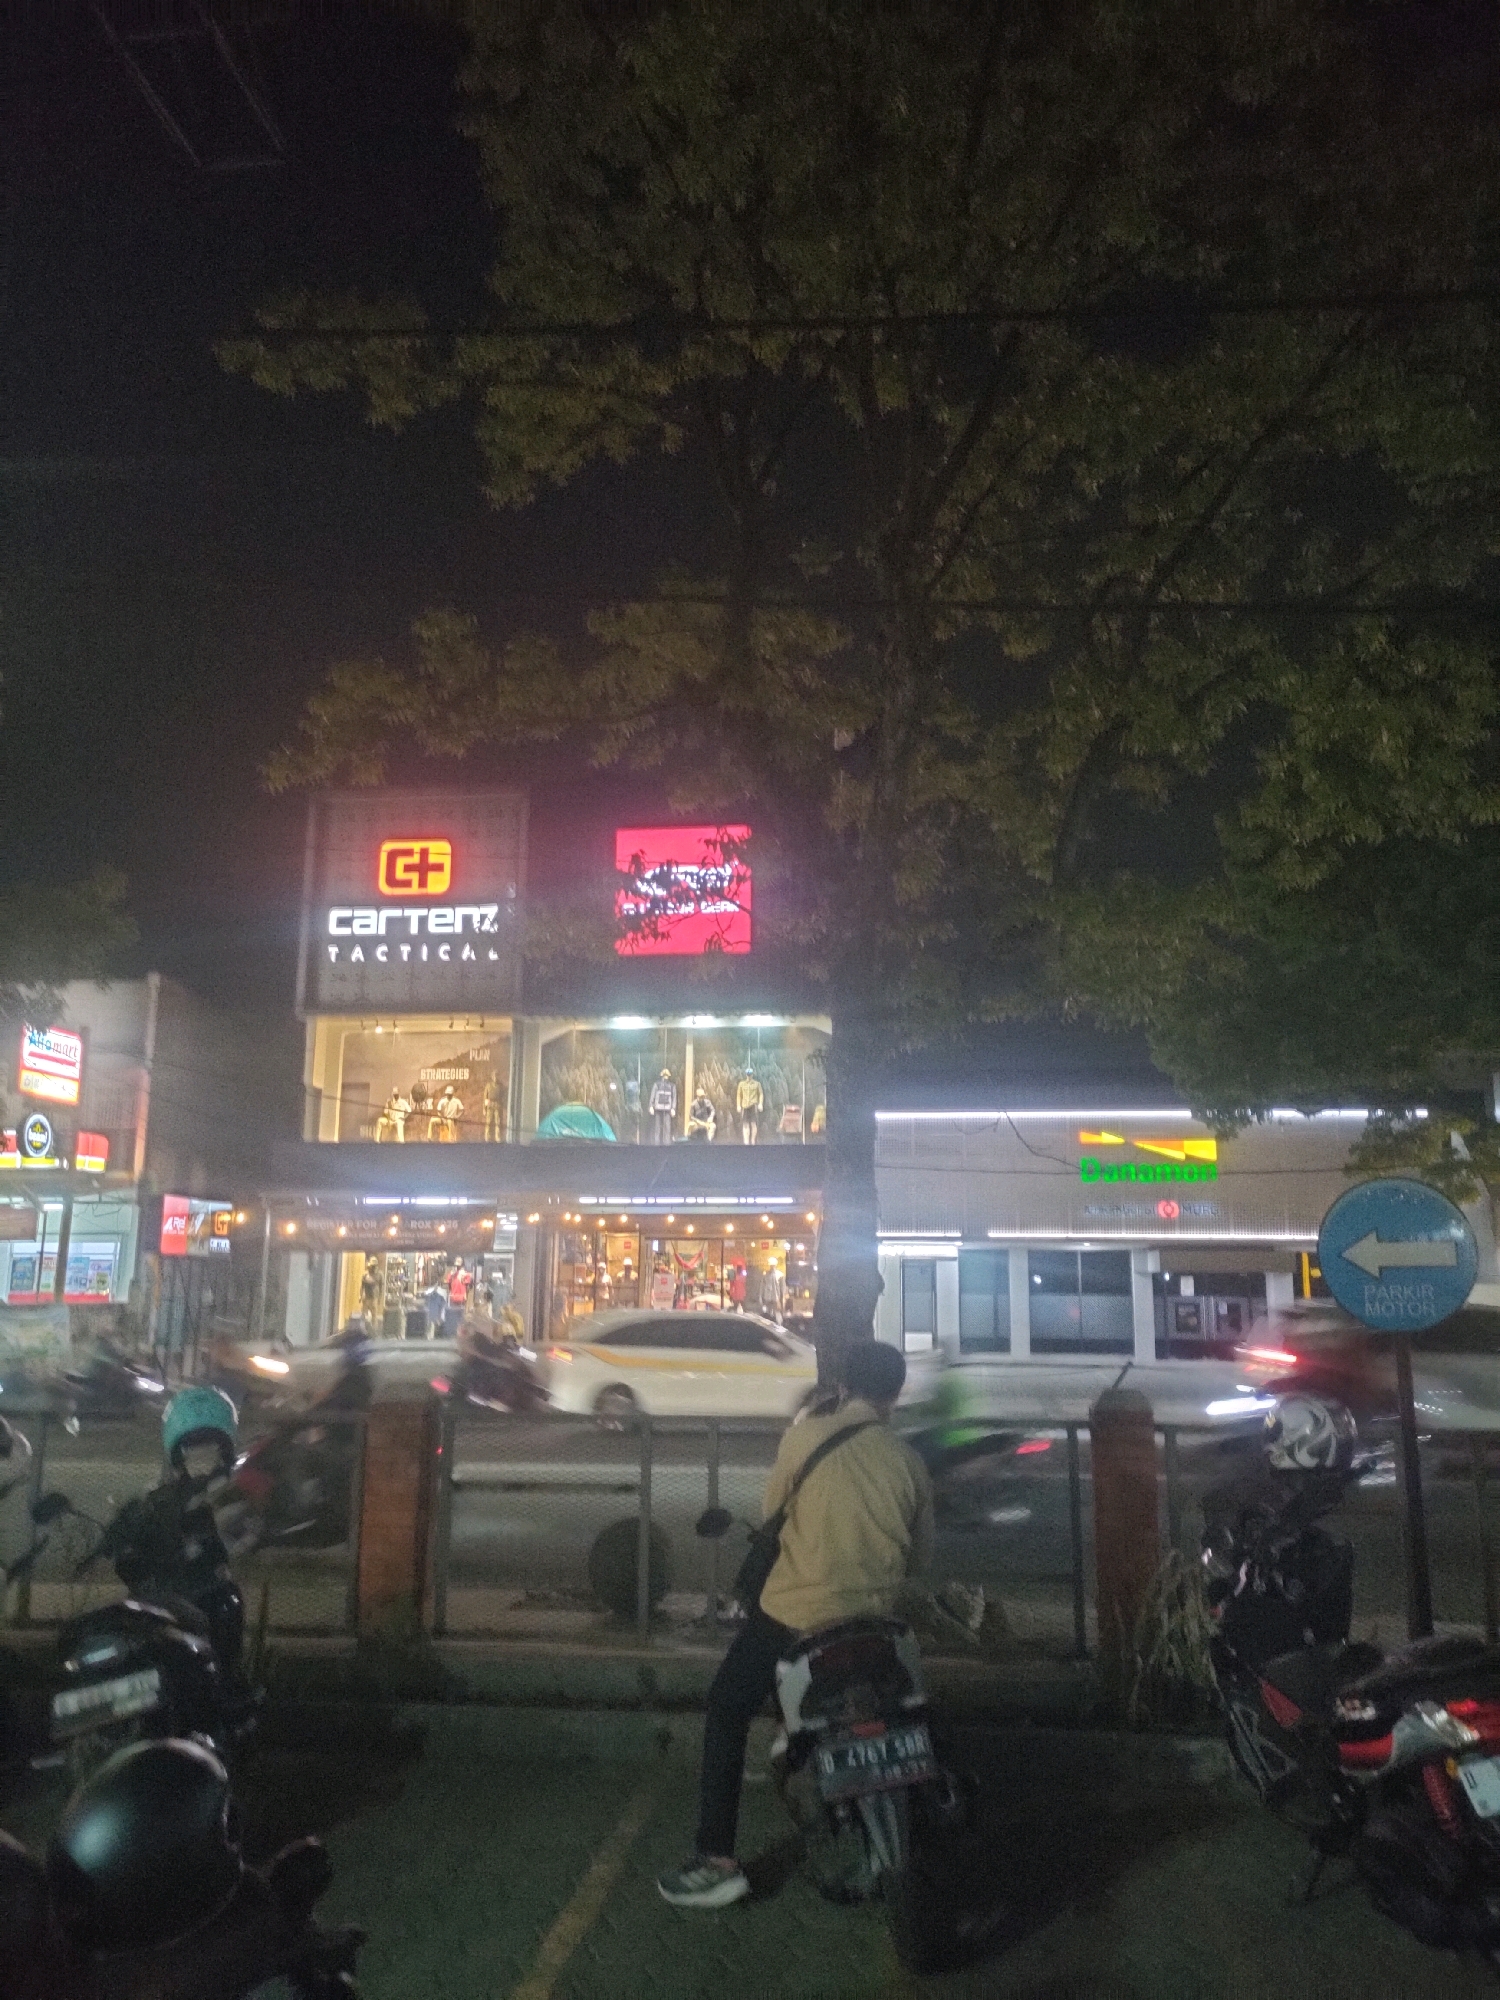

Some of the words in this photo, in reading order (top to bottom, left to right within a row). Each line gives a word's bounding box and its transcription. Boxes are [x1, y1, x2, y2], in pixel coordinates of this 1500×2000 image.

[327, 944, 499, 962] TACTICAL
[420, 1068, 470, 1081] STRATEGIES
[1080, 1157, 1218, 1183] Danamon
[1364, 1285, 1434, 1301] PARKIR
[1365, 1301, 1436, 1318] MOTOR
